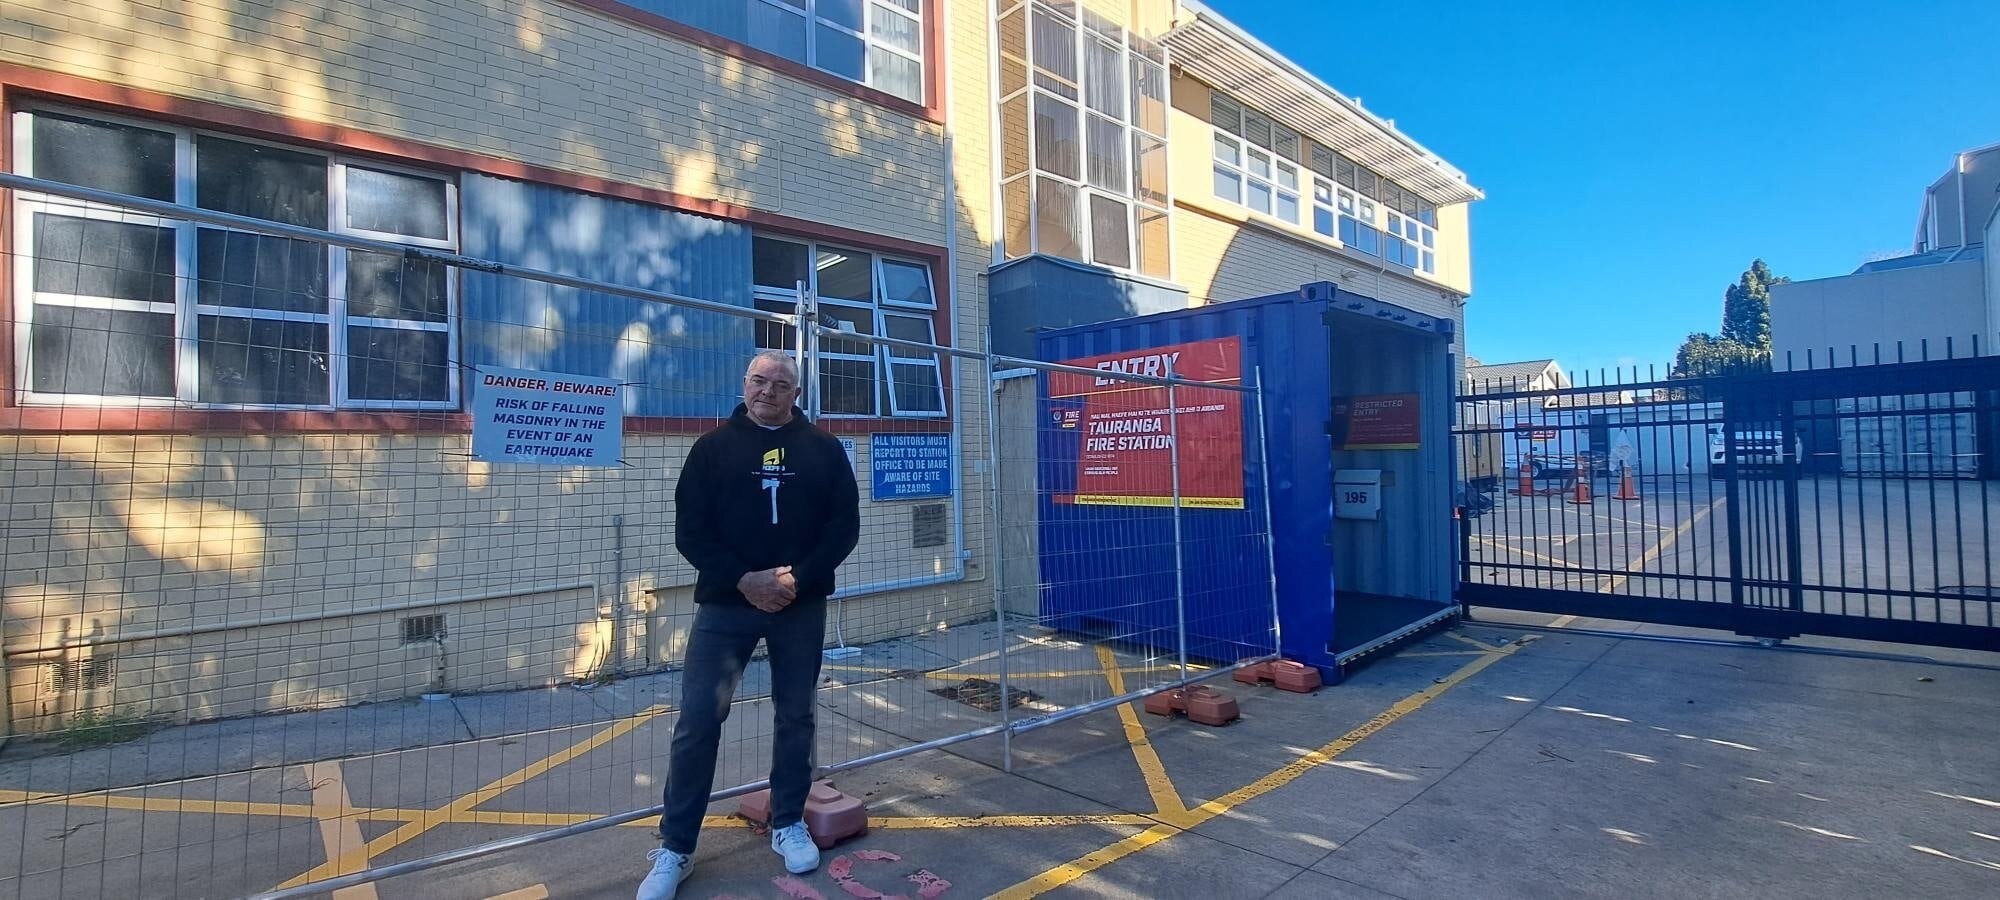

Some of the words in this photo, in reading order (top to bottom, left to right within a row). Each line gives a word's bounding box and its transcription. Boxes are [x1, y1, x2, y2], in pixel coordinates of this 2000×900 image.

[1095, 352, 1180, 386] ENTRY
[484, 375, 549, 391] DANGER,
[554, 381, 617, 397] BEWARE!
[496, 398, 527, 410] RISK
[531, 401, 549, 411] OF
[552, 403, 605, 415] FALLING
[1354, 400, 1403, 409] RESTRICTED
[1065, 410, 1080, 419] FIRE
[493, 413, 562, 427] MASONRY
[565, 418, 579, 428] IN
[582, 420, 606, 430] THE
[1089, 417, 1162, 436] TAURANGA
[507, 430, 552, 441] EVENT
[554, 432, 572, 442] OF
[573, 433, 593, 443] AN
[874, 436, 888, 446] ALL
[891, 436, 925, 446] VISITORS
[926, 436, 947, 446] MUST
[1086, 436, 1115, 452] FIRE
[1118, 435, 1174, 451] STATION
[505, 444, 594, 458] EARTHQUAKE
[874, 448, 904, 458] REPORT
[907, 448, 917, 457] TO
[919, 448, 947, 457] STATION
[875, 460, 902, 471] OFFICE
[904, 460, 914, 470] TO
[917, 460, 926, 469] BE
[928, 459, 948, 469] MADE
[885, 472, 911, 482] AWARE
[912, 472, 922, 481] OF
[924, 471, 940, 481] SITE
[896, 483, 931, 494] HAZARDS
[1344, 491, 1367, 504] 195
